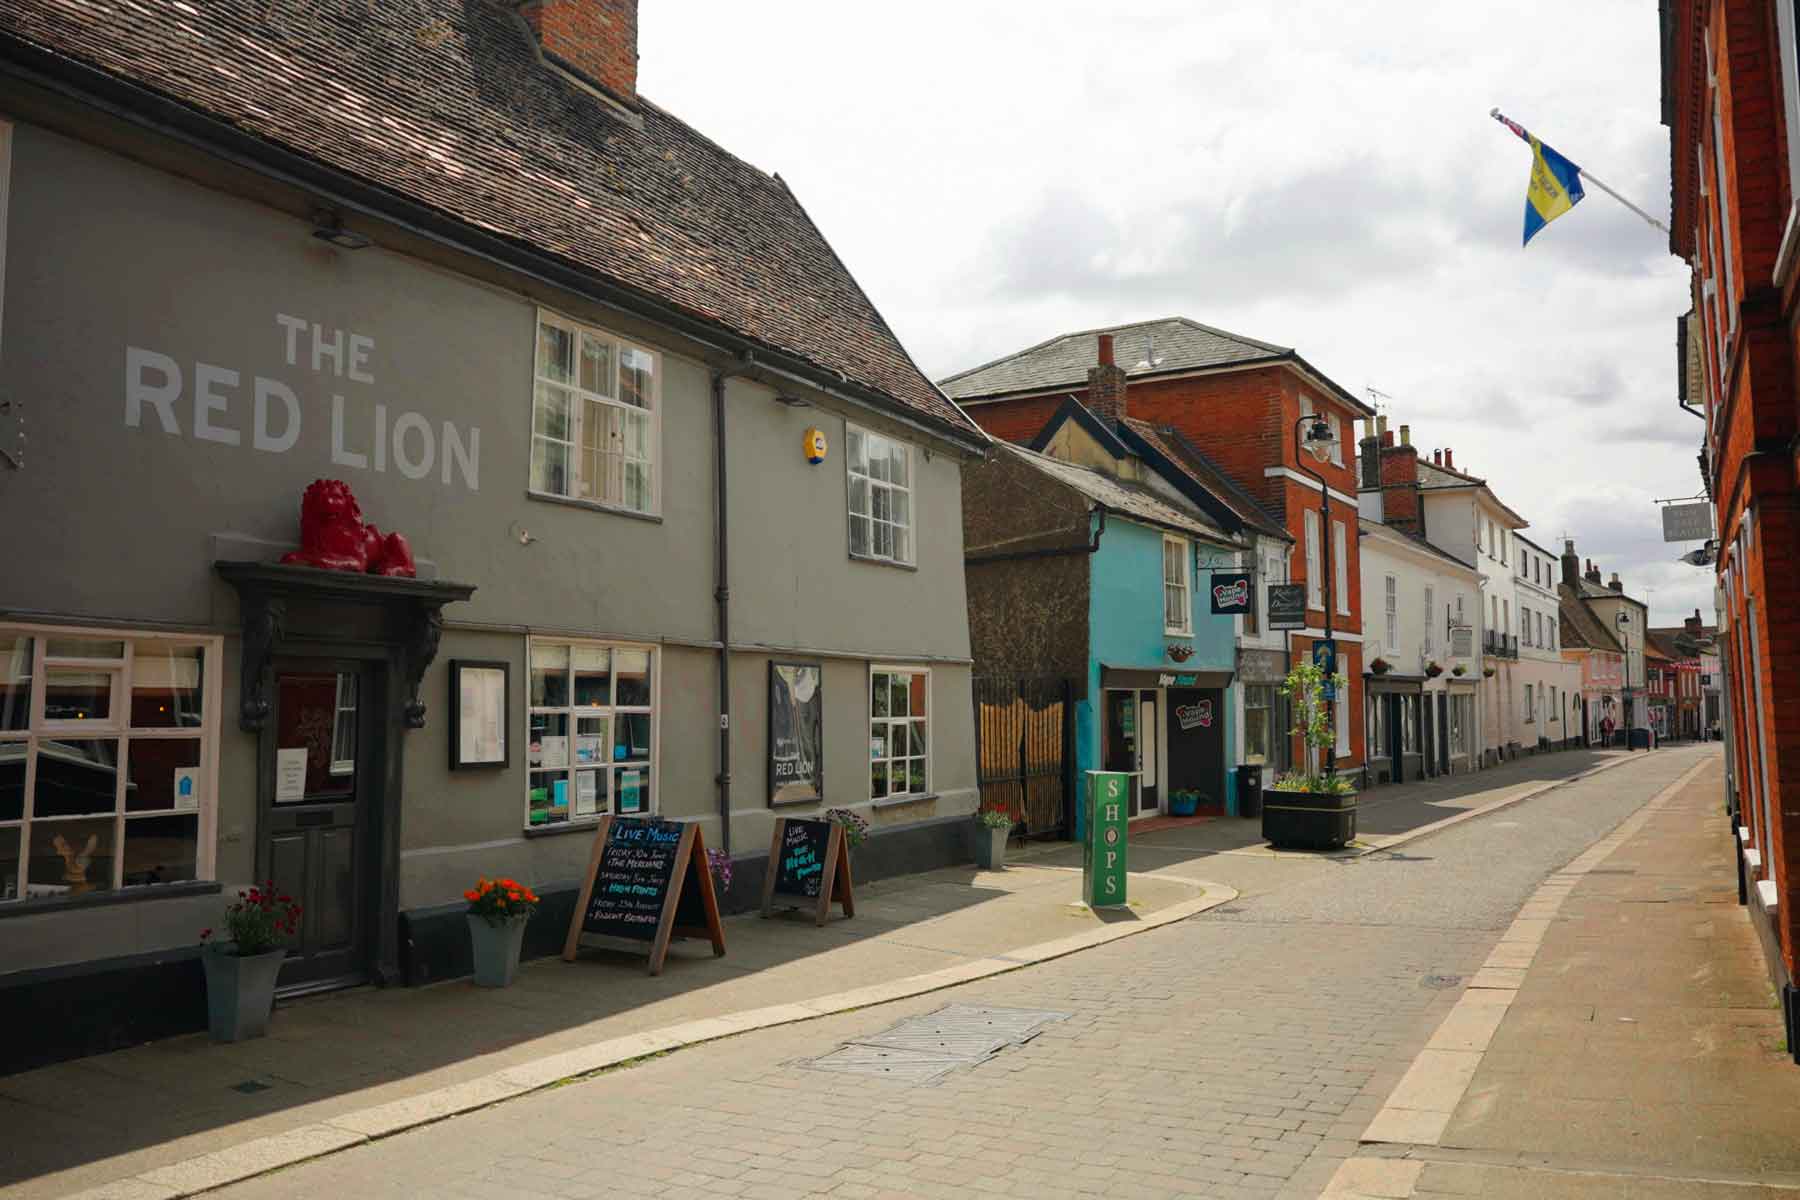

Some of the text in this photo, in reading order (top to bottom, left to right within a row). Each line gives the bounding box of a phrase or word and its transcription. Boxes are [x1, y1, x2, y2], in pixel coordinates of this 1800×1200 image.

[276, 312, 375, 385] THE
[124, 345, 481, 490] RED LION
[776, 760, 814, 776] RED LION
[1104, 778, 1120, 895] SHOPS
